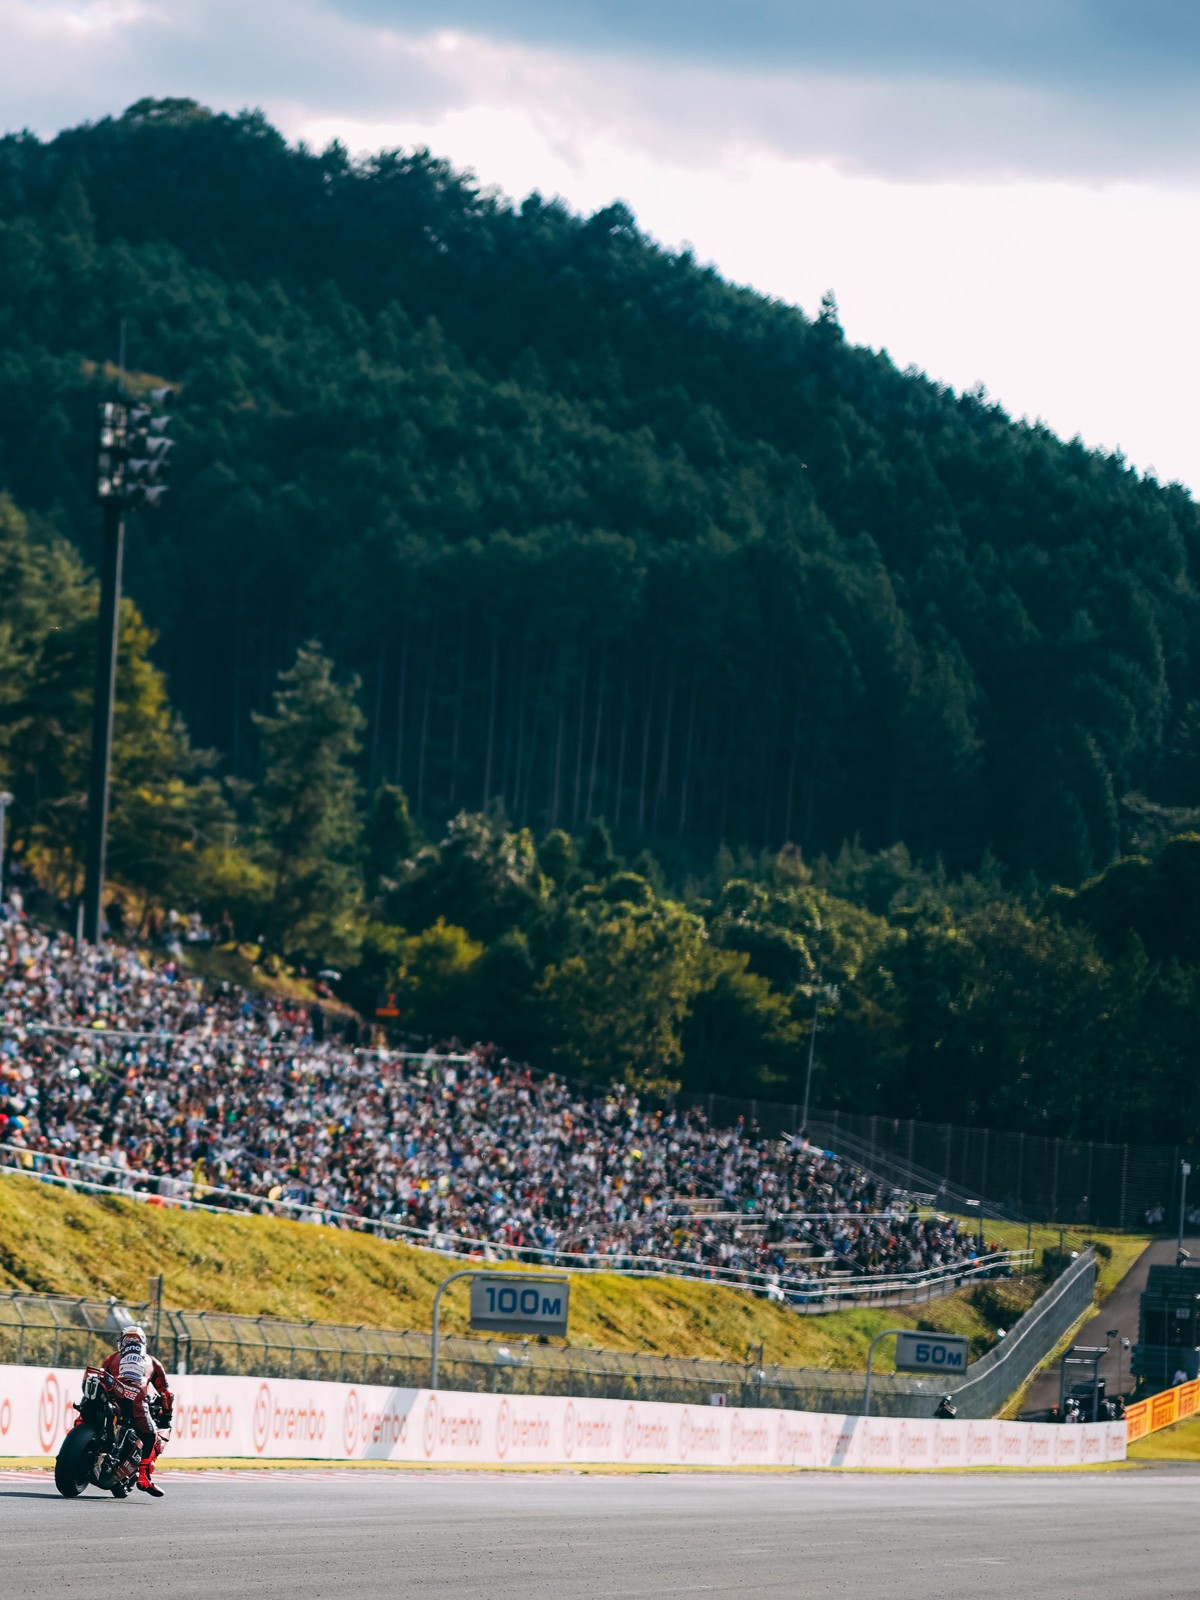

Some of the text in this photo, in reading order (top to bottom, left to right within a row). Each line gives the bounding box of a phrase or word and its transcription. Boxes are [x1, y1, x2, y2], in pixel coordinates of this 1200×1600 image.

[486, 1287, 561, 1316] 100M
[915, 1343, 962, 1367] 50M
[175, 1393, 233, 1438] brembo
[273, 1399, 326, 1441] brembo
[361, 1404, 407, 1444] brembo
